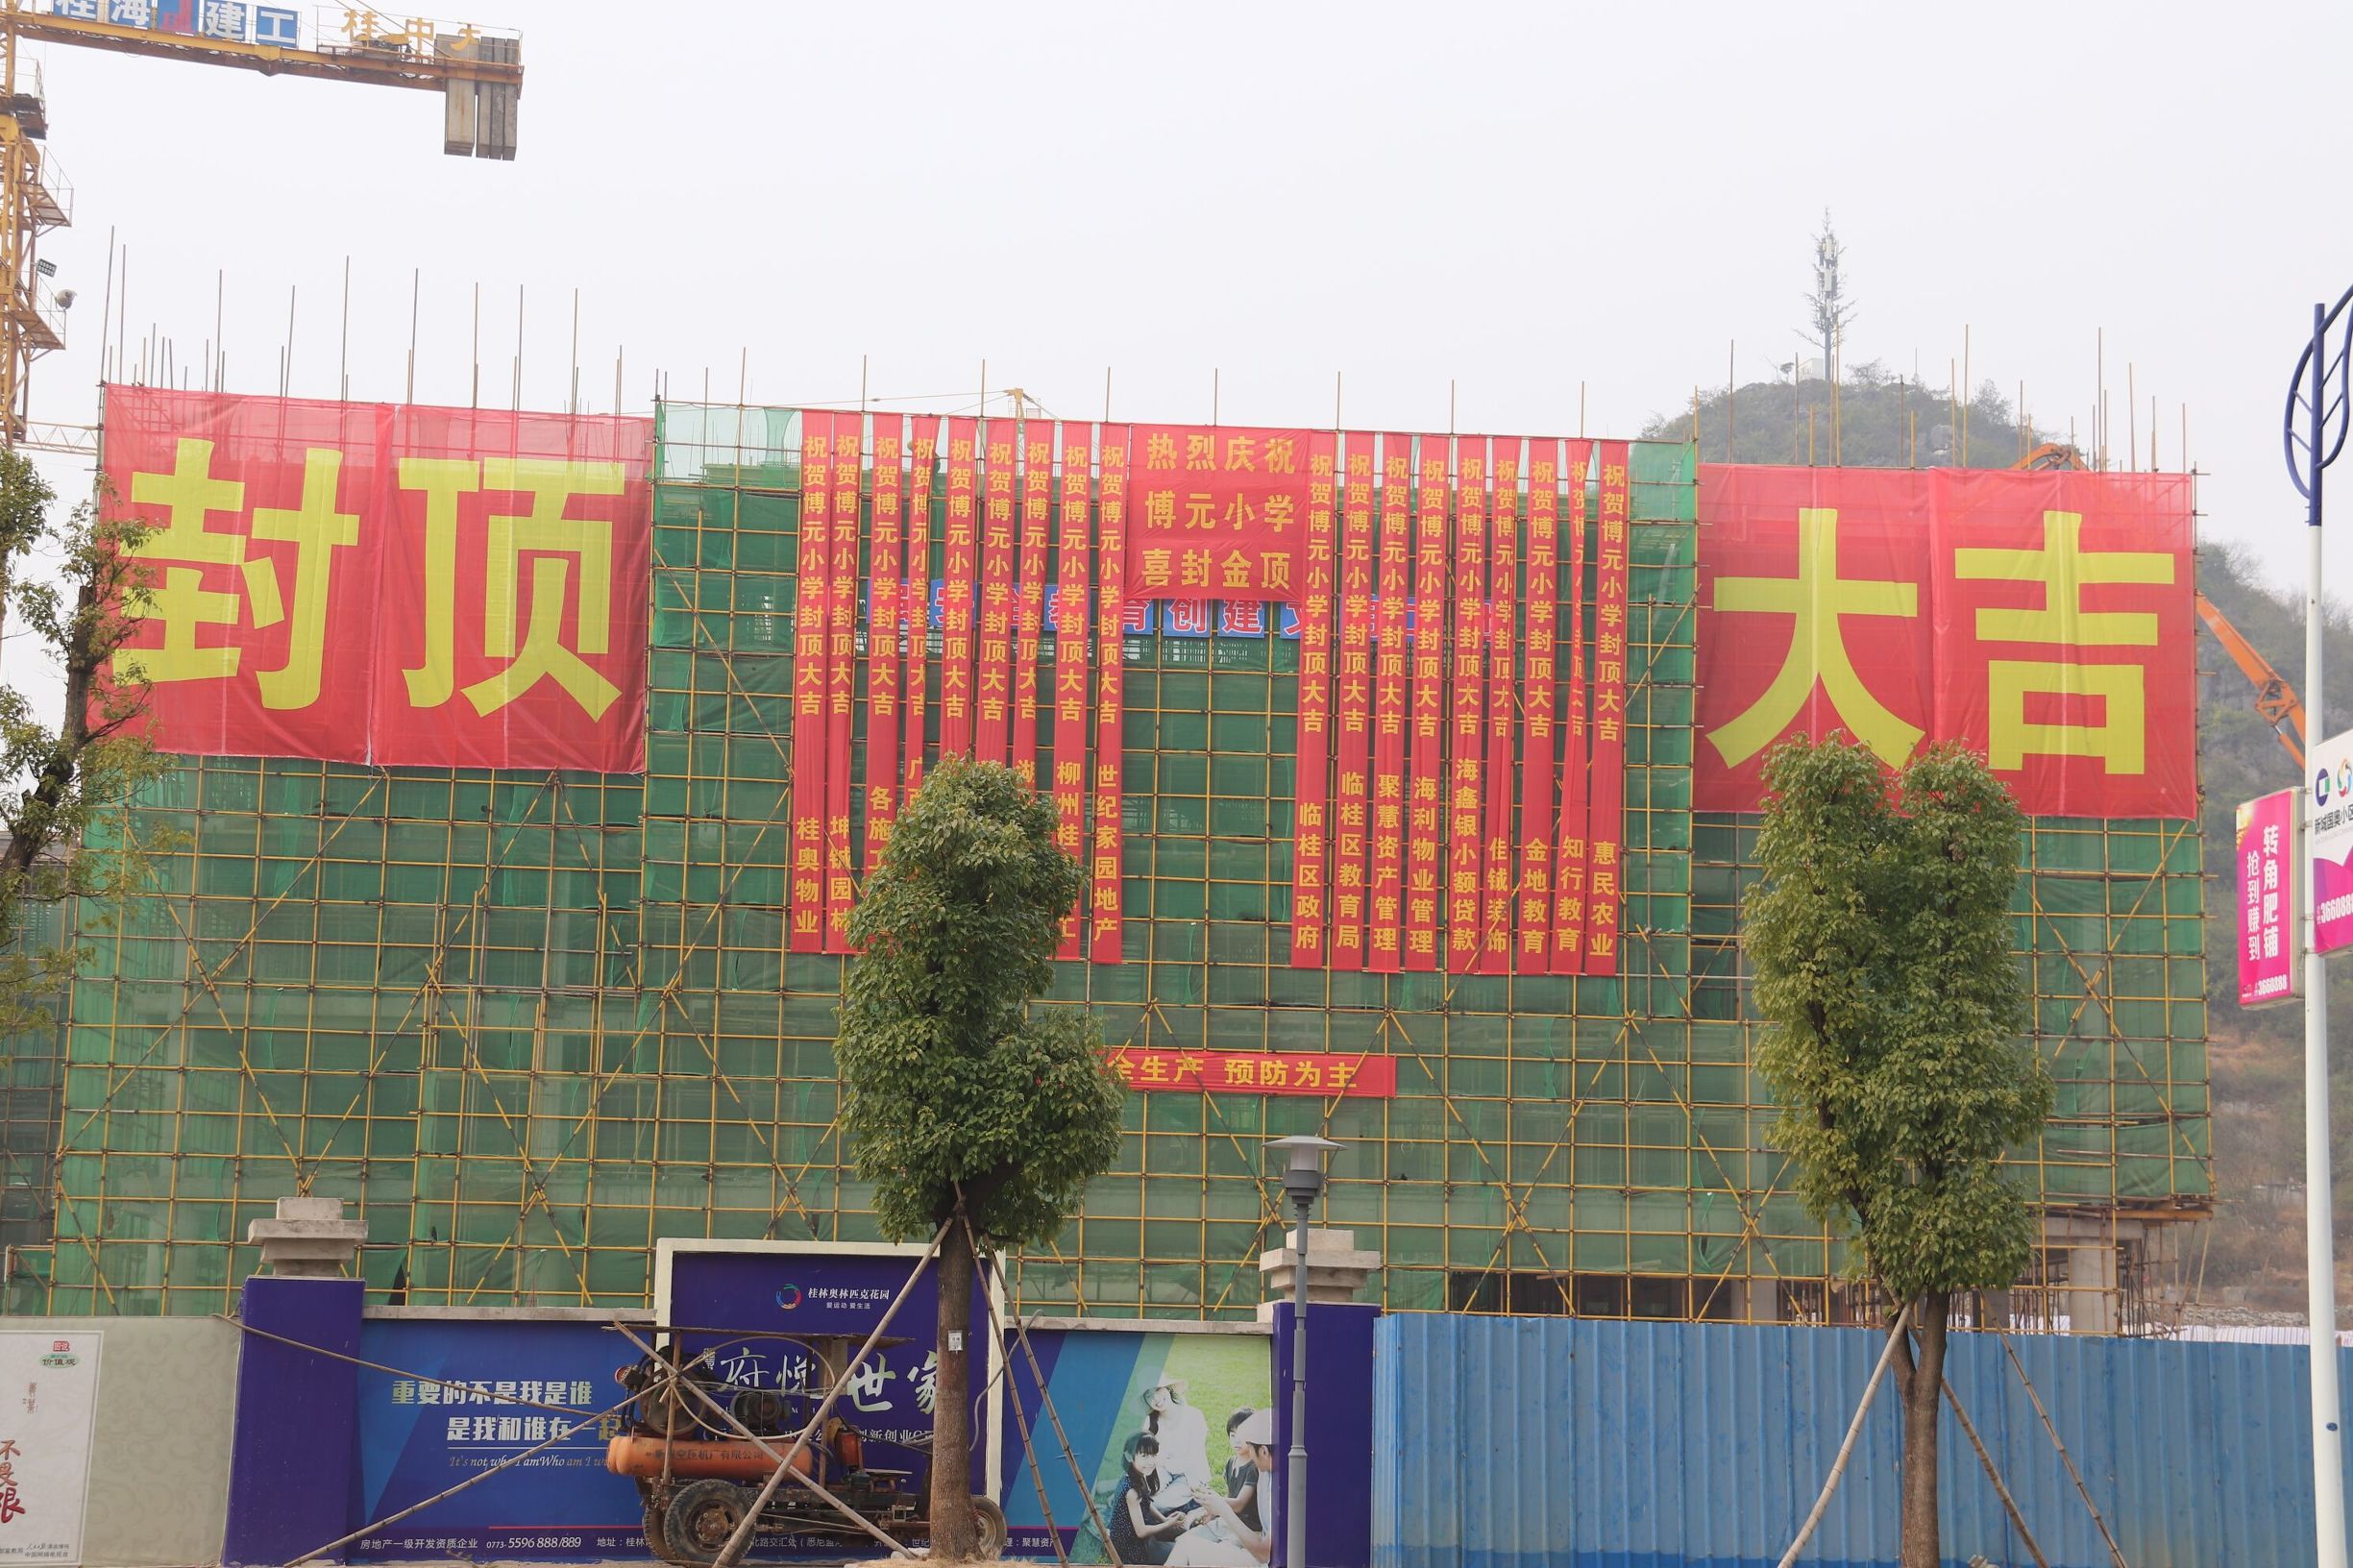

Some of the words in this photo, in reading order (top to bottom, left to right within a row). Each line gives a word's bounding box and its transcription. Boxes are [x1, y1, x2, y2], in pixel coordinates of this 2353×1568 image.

[206, 2, 296, 44] 建工
[1145, 489, 1295, 533] 博元小学
[1146, 432, 1295, 475] 热烈庆祝
[112, 438, 625, 723] 封顶
[1141, 548, 1291, 591] 喜封金顶
[1705, 508, 2175, 775] 大吉
[794, 817, 820, 934] 桂奥物业
[1093, 765, 1118, 941] 世纪家园地产
[1295, 802, 1322, 949] 临桂区政府
[1336, 772, 1364, 949] 临桂区教育局
[1373, 773, 1401, 951] 聚慧资产管理
[1409, 776, 1436, 953] 海利物业管理
[1452, 758, 1479, 951] 海鑫银小额贷款
[1522, 838, 1549, 954] 金地教育
[1556, 835, 1583, 952] 知行教育
[1589, 841, 1617, 957] 惠民农业
[2246, 849, 2260, 961] 抢到赚到
[2263, 823, 2279, 959] 转角肥铺
[1224, 1057, 1358, 1089] 预防为主
[808, 1287, 890, 1300] 桂林奥林匹克花园
[392, 1380, 592, 1407] 重要的不是我是谁
[447, 1416, 623, 1442] 是我和谁在一起
[360, 1537, 478, 1551] 房地产一级开发资质企业
